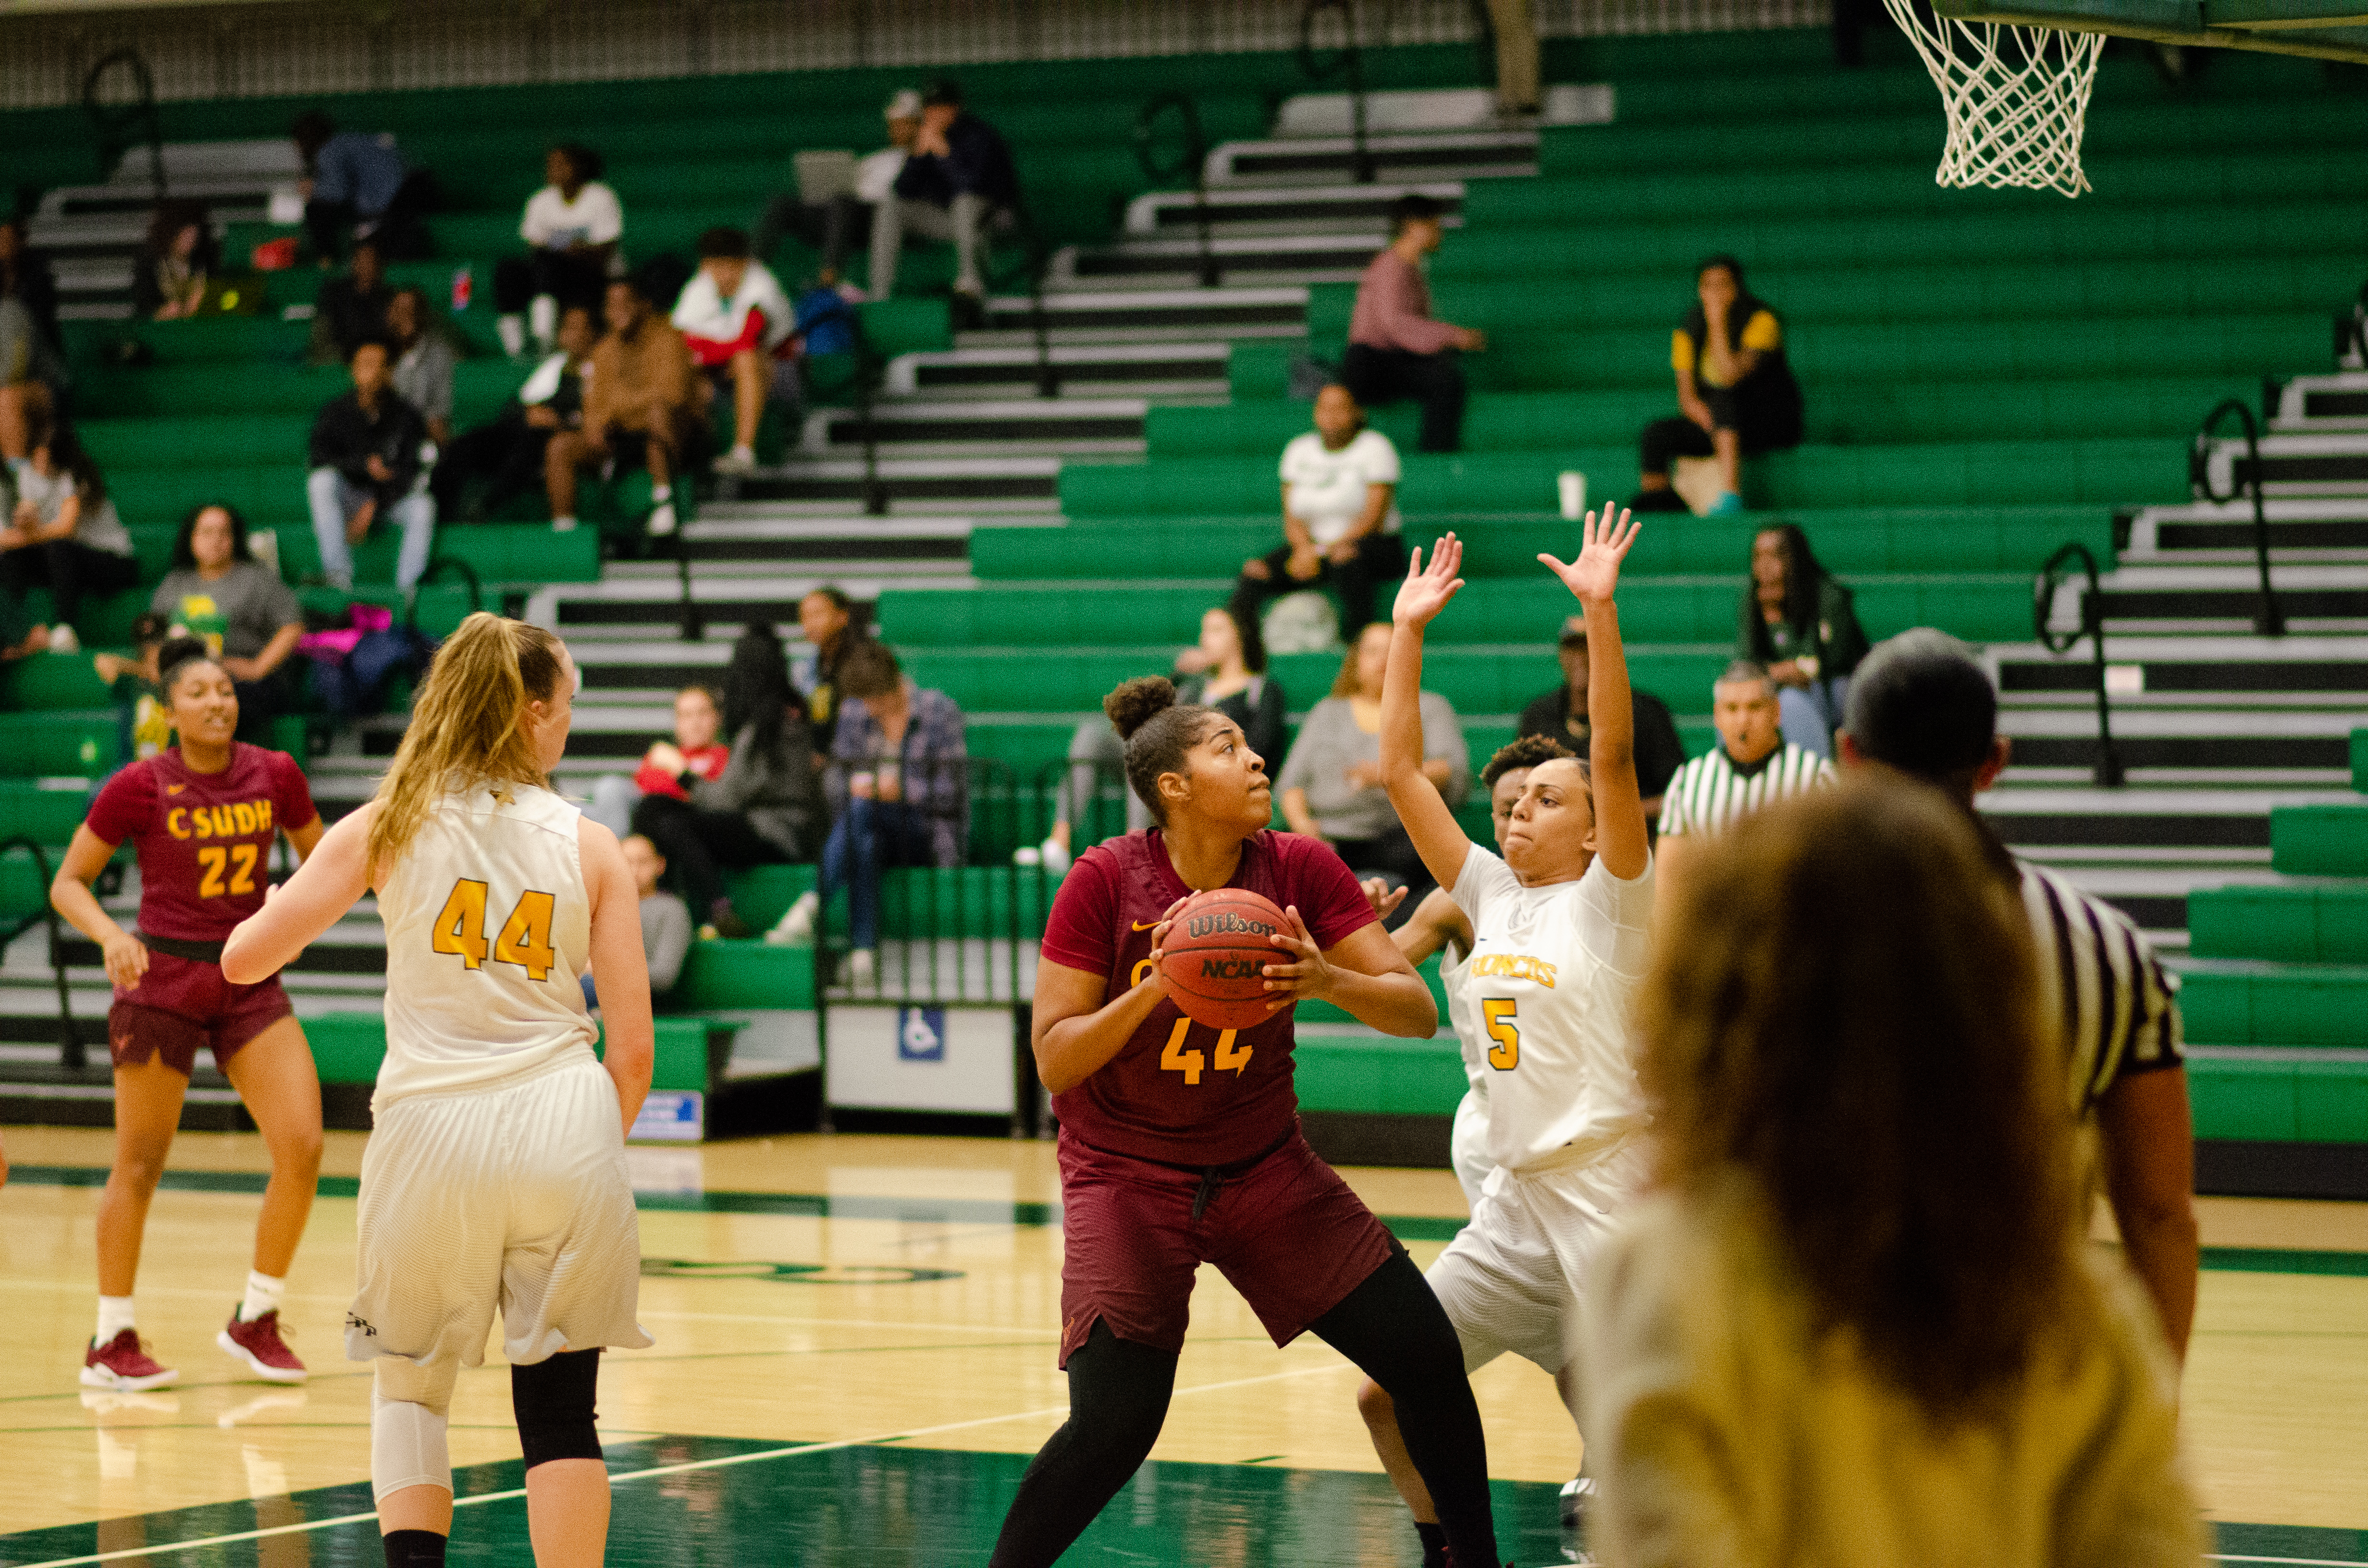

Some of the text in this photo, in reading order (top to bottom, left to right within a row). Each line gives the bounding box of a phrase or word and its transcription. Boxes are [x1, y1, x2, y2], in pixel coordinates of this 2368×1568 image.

[168, 799, 272, 839] CSUDH
[198, 844, 258, 899] 22
[432, 878, 555, 982] 44
[1188, 912, 1277, 939] Wilson
[1161, 1017, 1253, 1085] 44
[1481, 998, 1519, 1071] 5
